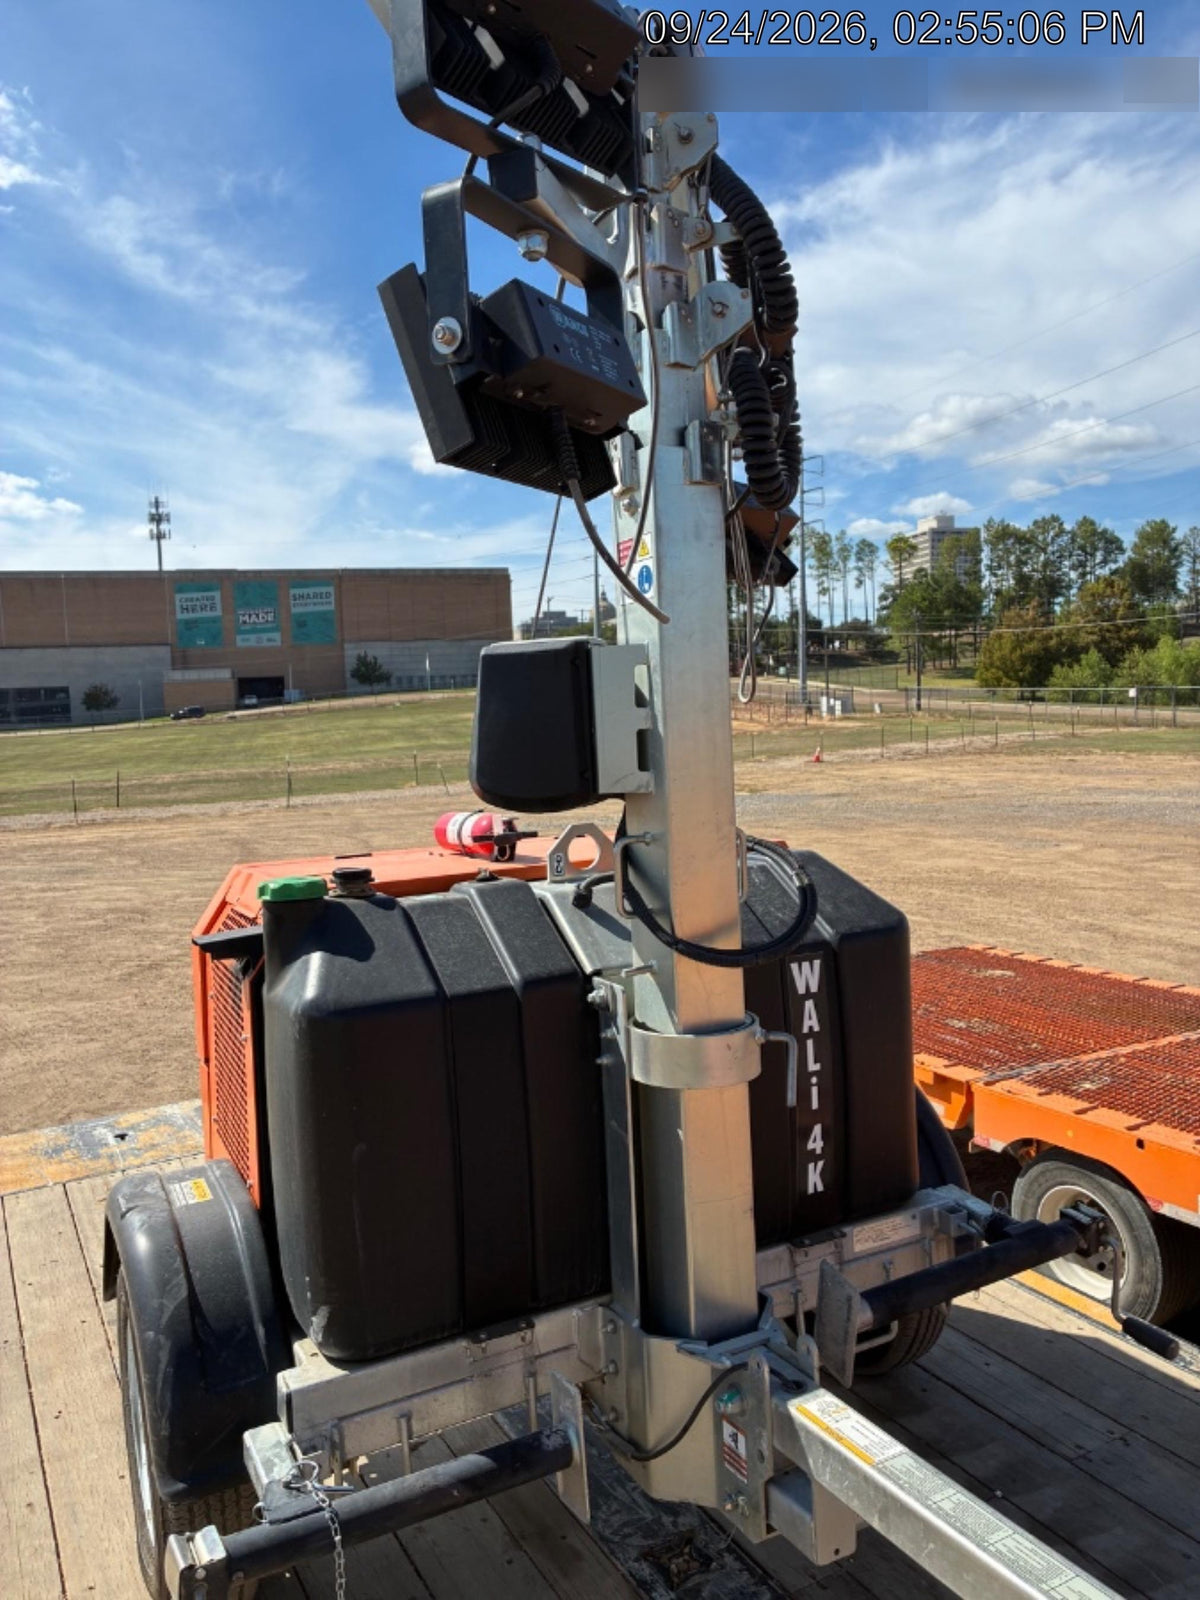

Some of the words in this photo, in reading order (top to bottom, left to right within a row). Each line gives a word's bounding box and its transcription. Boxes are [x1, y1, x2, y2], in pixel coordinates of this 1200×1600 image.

[292, 591, 332, 601] SHARED
[180, 602, 217, 614] HERE
[239, 613, 275, 624] MADE
[806, 1123, 824, 1195] 4K
